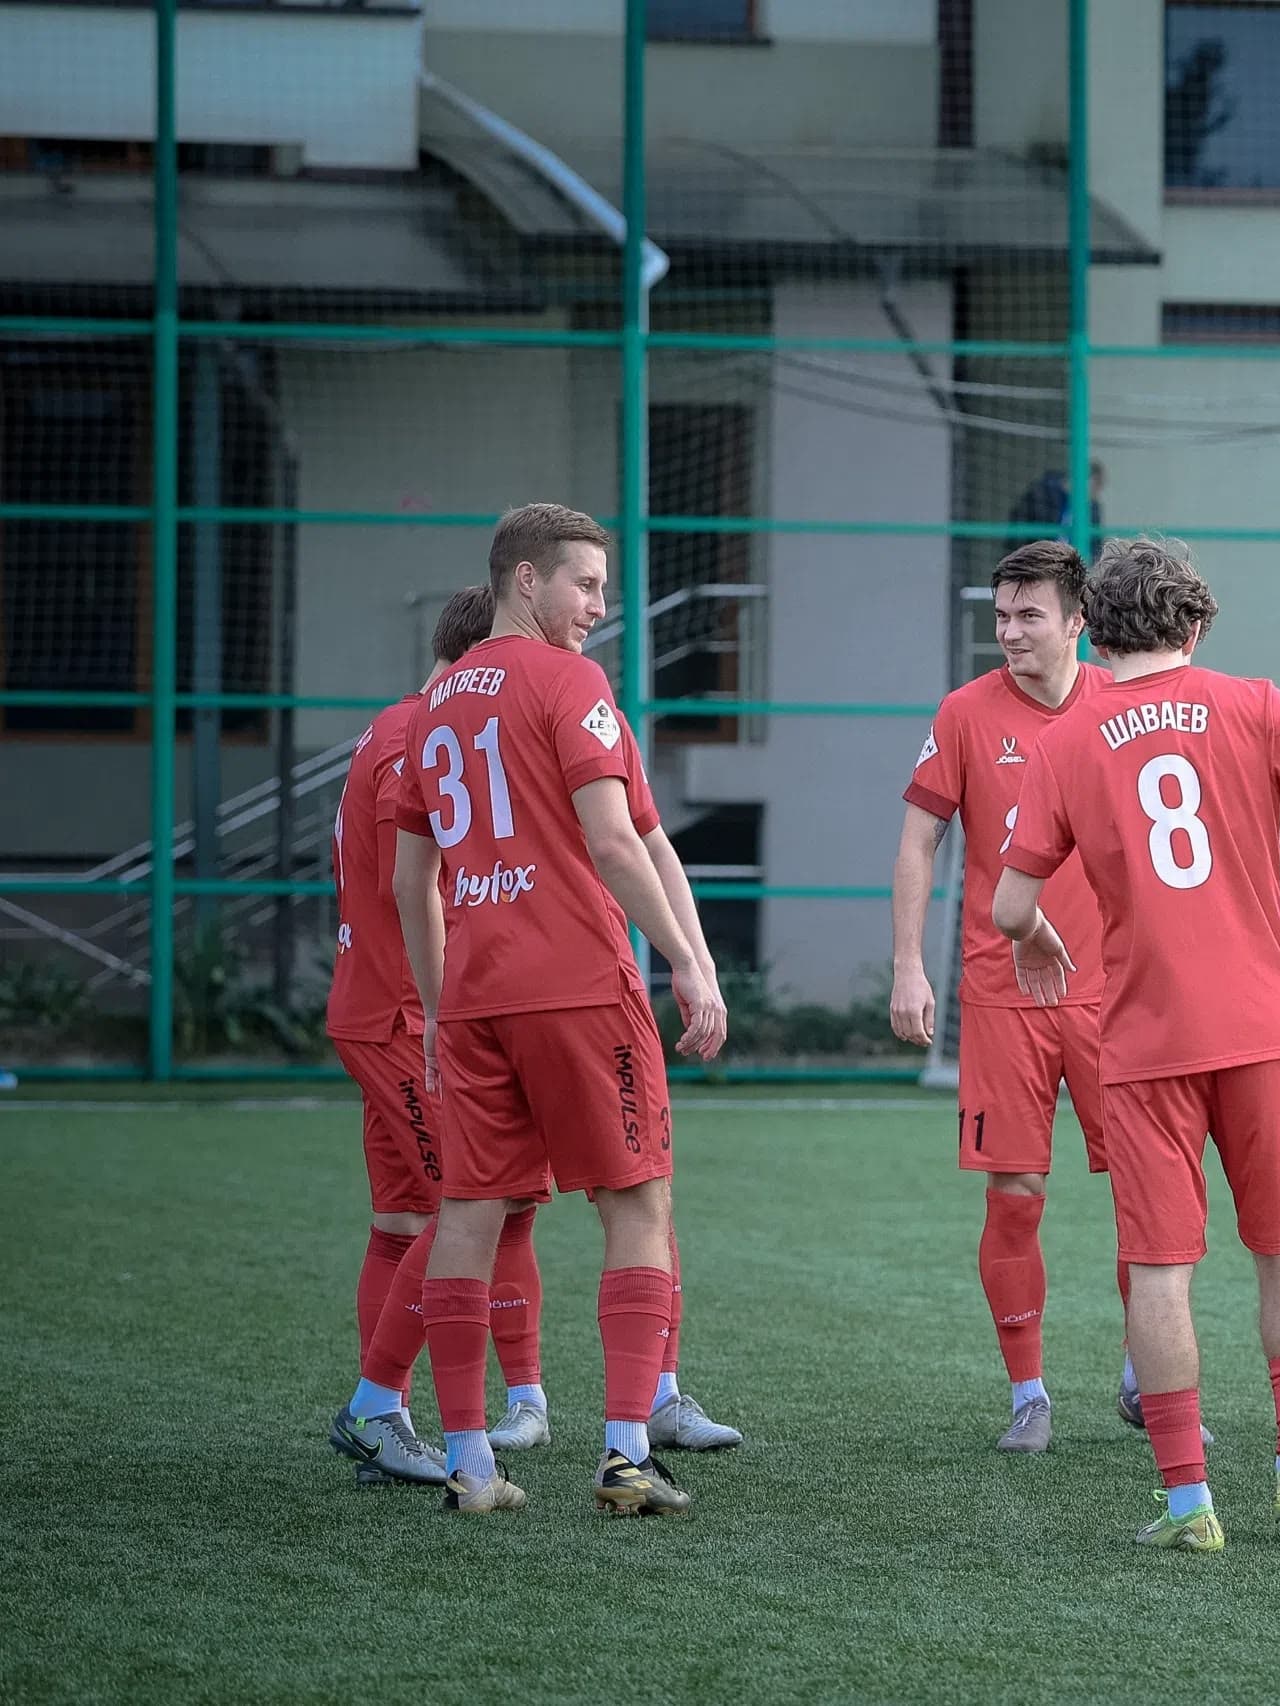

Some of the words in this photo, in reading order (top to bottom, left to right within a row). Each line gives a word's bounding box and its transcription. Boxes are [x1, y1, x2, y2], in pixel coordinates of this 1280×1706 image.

[429, 667, 507, 713] МАТВЕЕВ
[1098, 700, 1210, 752] ШАВАЕВ
[421, 716, 515, 850] 31
[1136, 753, 1214, 890] 8
